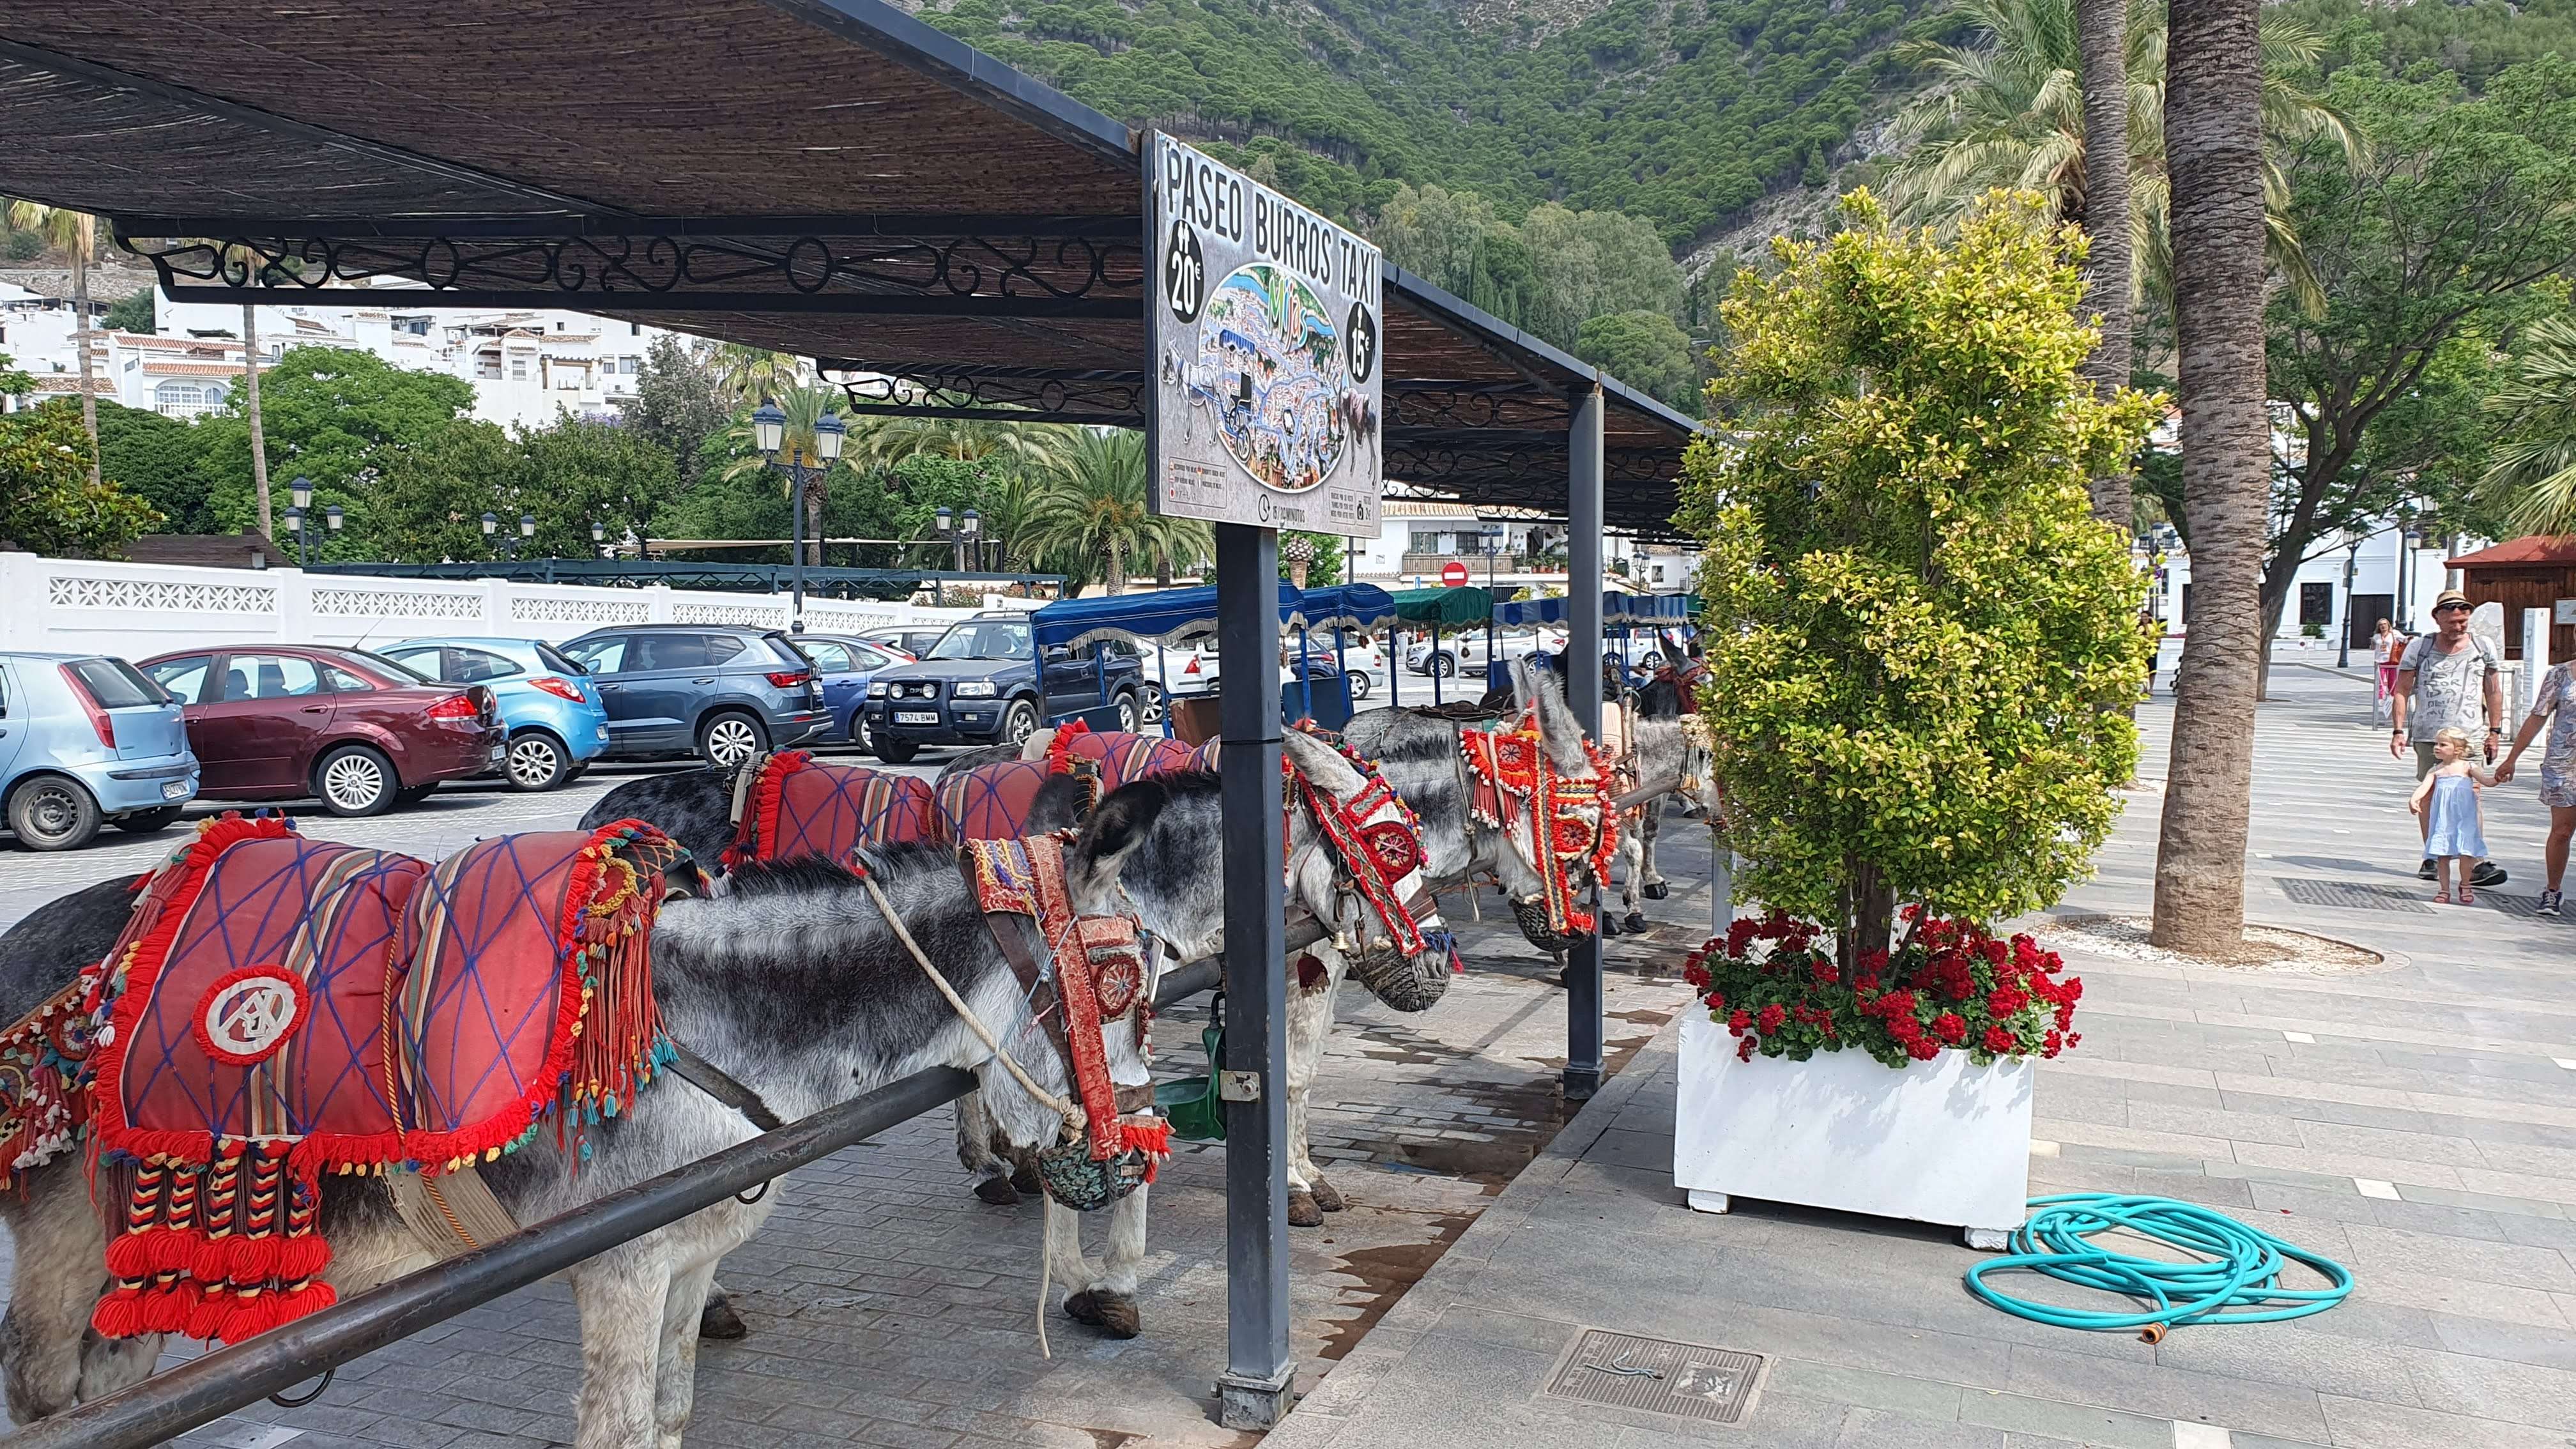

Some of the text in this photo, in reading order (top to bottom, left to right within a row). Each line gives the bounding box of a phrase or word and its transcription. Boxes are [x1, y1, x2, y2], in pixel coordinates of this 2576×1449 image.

[1167, 148, 1377, 307] PASEO BURROS TAXI
[1172, 250, 1201, 315] 20€
[1268, 275, 1308, 353] Mijas
[1351, 327, 1370, 378] 15€
[900, 714, 936, 722] 7574 BMM
